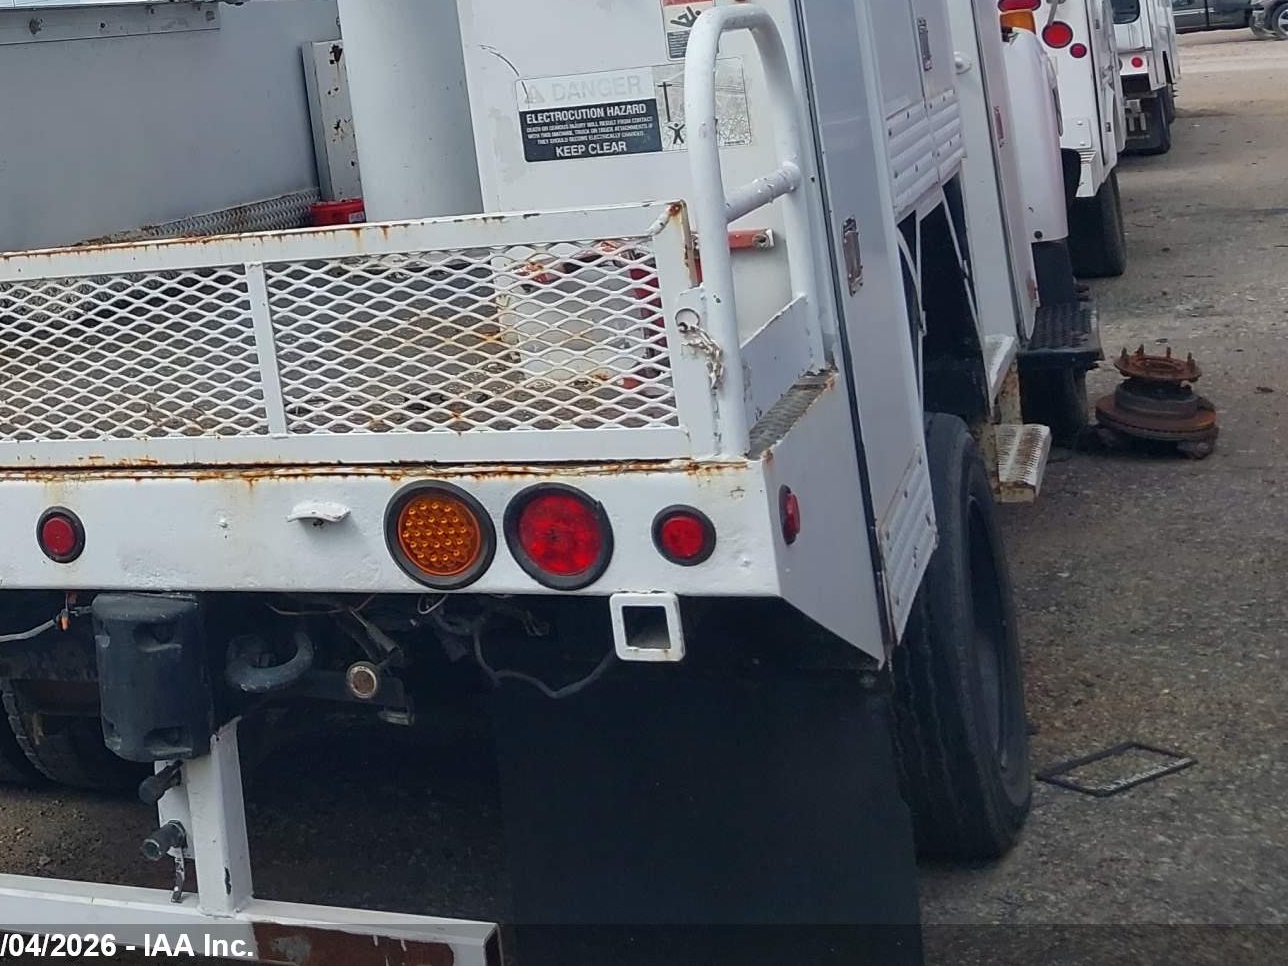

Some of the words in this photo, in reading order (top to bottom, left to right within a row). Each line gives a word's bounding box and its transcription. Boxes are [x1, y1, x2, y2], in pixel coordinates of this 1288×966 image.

[551, 75, 644, 102] DANGER
[526, 108, 605, 124] ELECTROCUTION
[606, 103, 647, 117] HAZARD
[555, 144, 586, 158] KEEP
[588, 141, 627, 155] CLEAR
